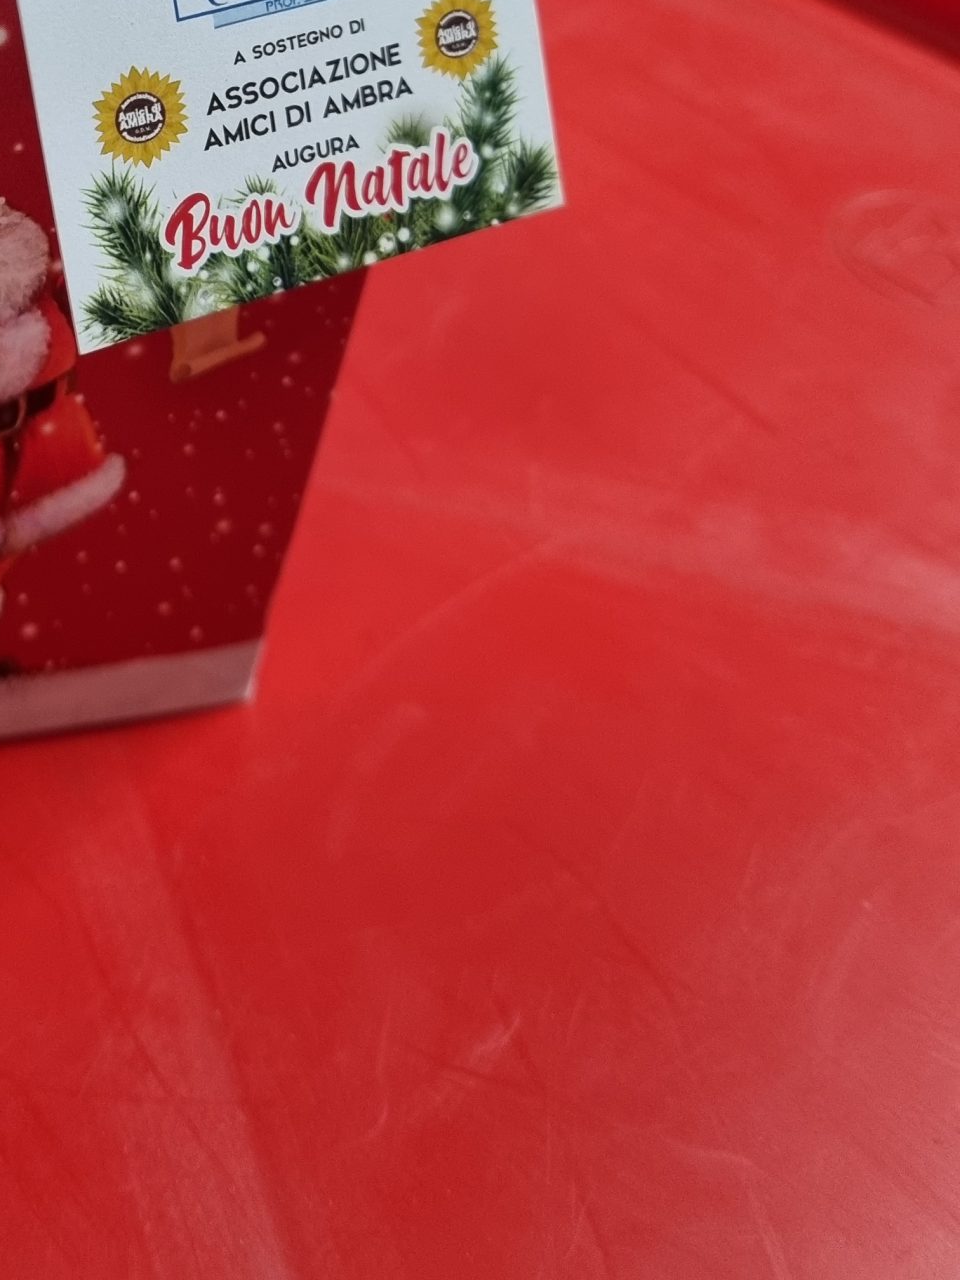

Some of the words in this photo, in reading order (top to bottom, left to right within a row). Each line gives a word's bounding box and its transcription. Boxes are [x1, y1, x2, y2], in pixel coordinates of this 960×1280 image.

[233, 50, 247, 66] A
[251, 24, 343, 60] SOSTEGNO
[349, 18, 366, 36] DI
[203, 111, 277, 151] AMICI
[285, 101, 312, 128] DI
[323, 76, 414, 119] AMBRA
[206, 43, 402, 115] ASSOCIAZIONE
[272, 134, 360, 173] AUGURA
[164, 192, 296, 270] Buon
[305, 132, 474, 228] Natale
